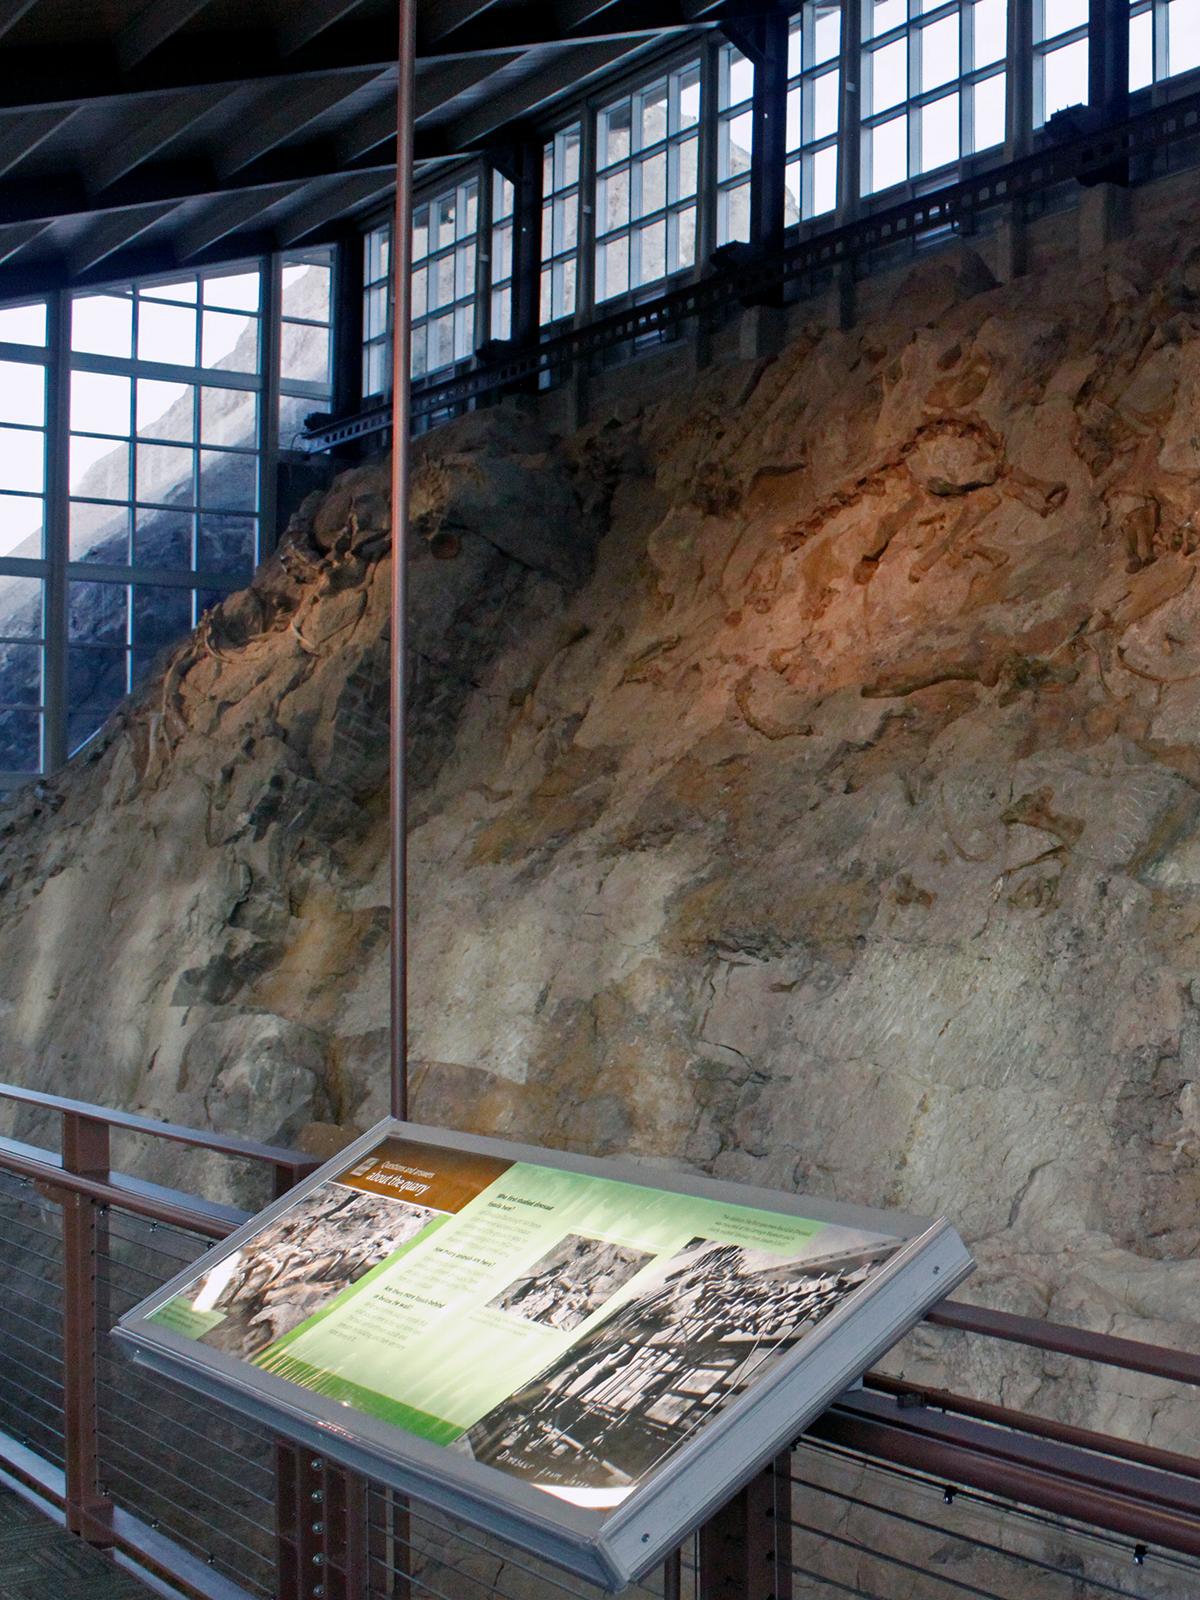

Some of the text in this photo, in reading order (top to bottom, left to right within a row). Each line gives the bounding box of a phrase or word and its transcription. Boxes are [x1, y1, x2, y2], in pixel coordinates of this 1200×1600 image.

[366, 1170, 432, 1197] about the quarry
